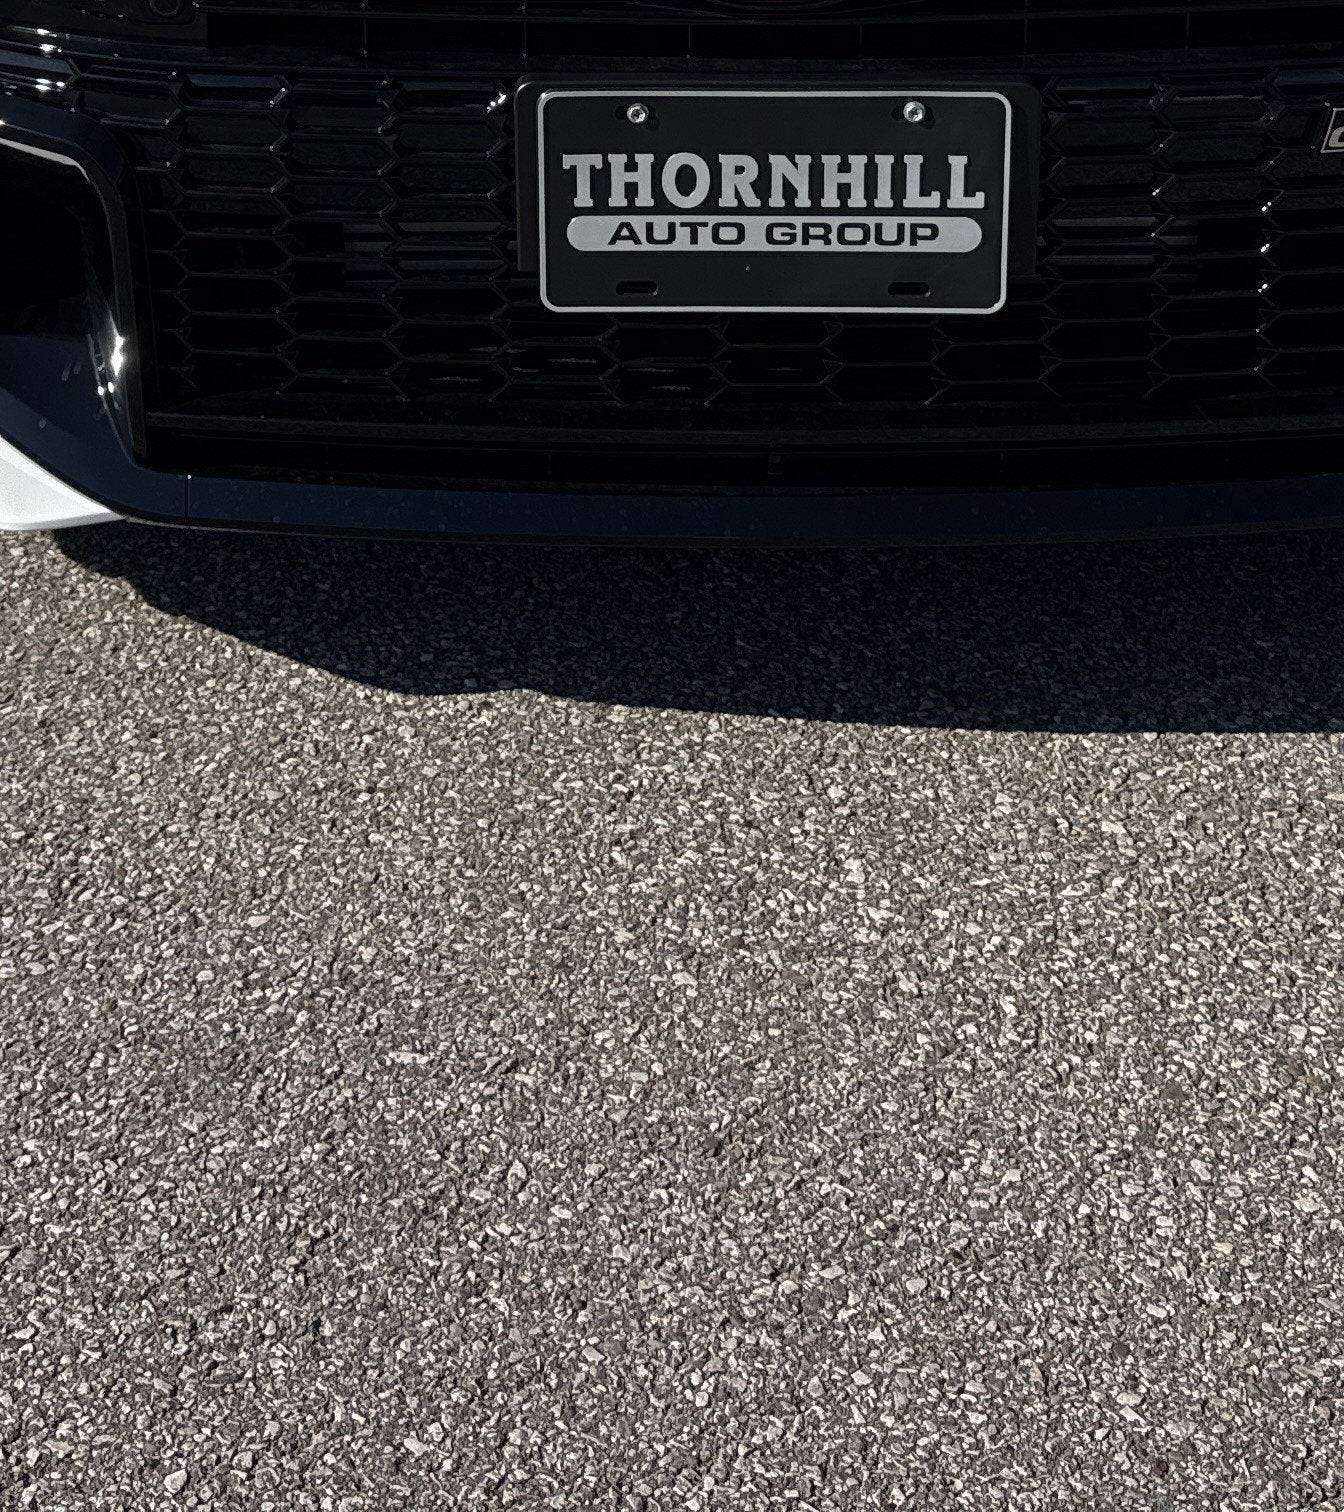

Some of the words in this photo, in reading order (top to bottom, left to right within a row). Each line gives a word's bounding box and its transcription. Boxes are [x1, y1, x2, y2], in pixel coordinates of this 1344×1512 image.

[562, 152, 986, 209] THORNHILL
[607, 220, 747, 246] AUTO
[764, 221, 940, 247] GROUP
